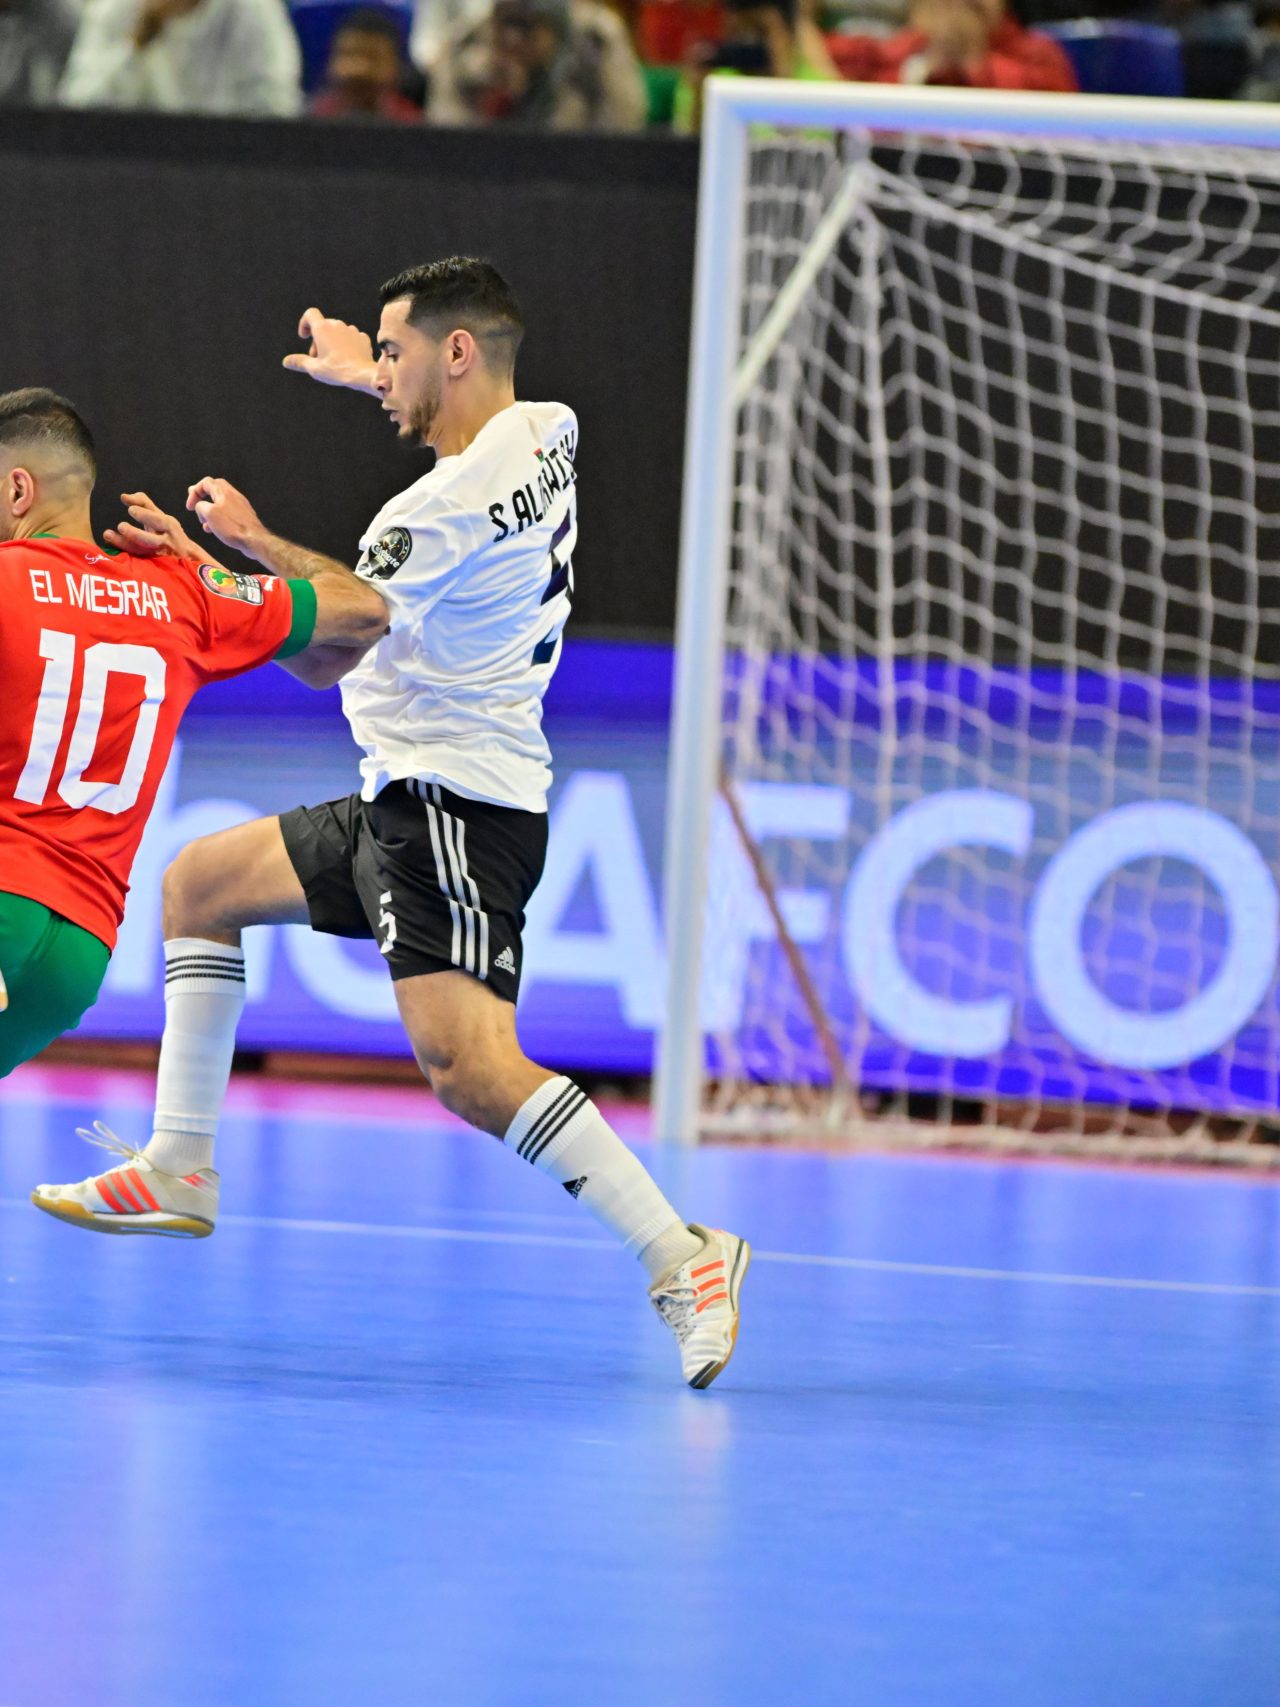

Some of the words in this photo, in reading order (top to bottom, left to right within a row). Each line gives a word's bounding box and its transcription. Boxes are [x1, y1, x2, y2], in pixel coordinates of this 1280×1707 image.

[29, 569, 63, 604] EL
[65, 572, 171, 623] MESRAR
[13, 628, 167, 814] 10
